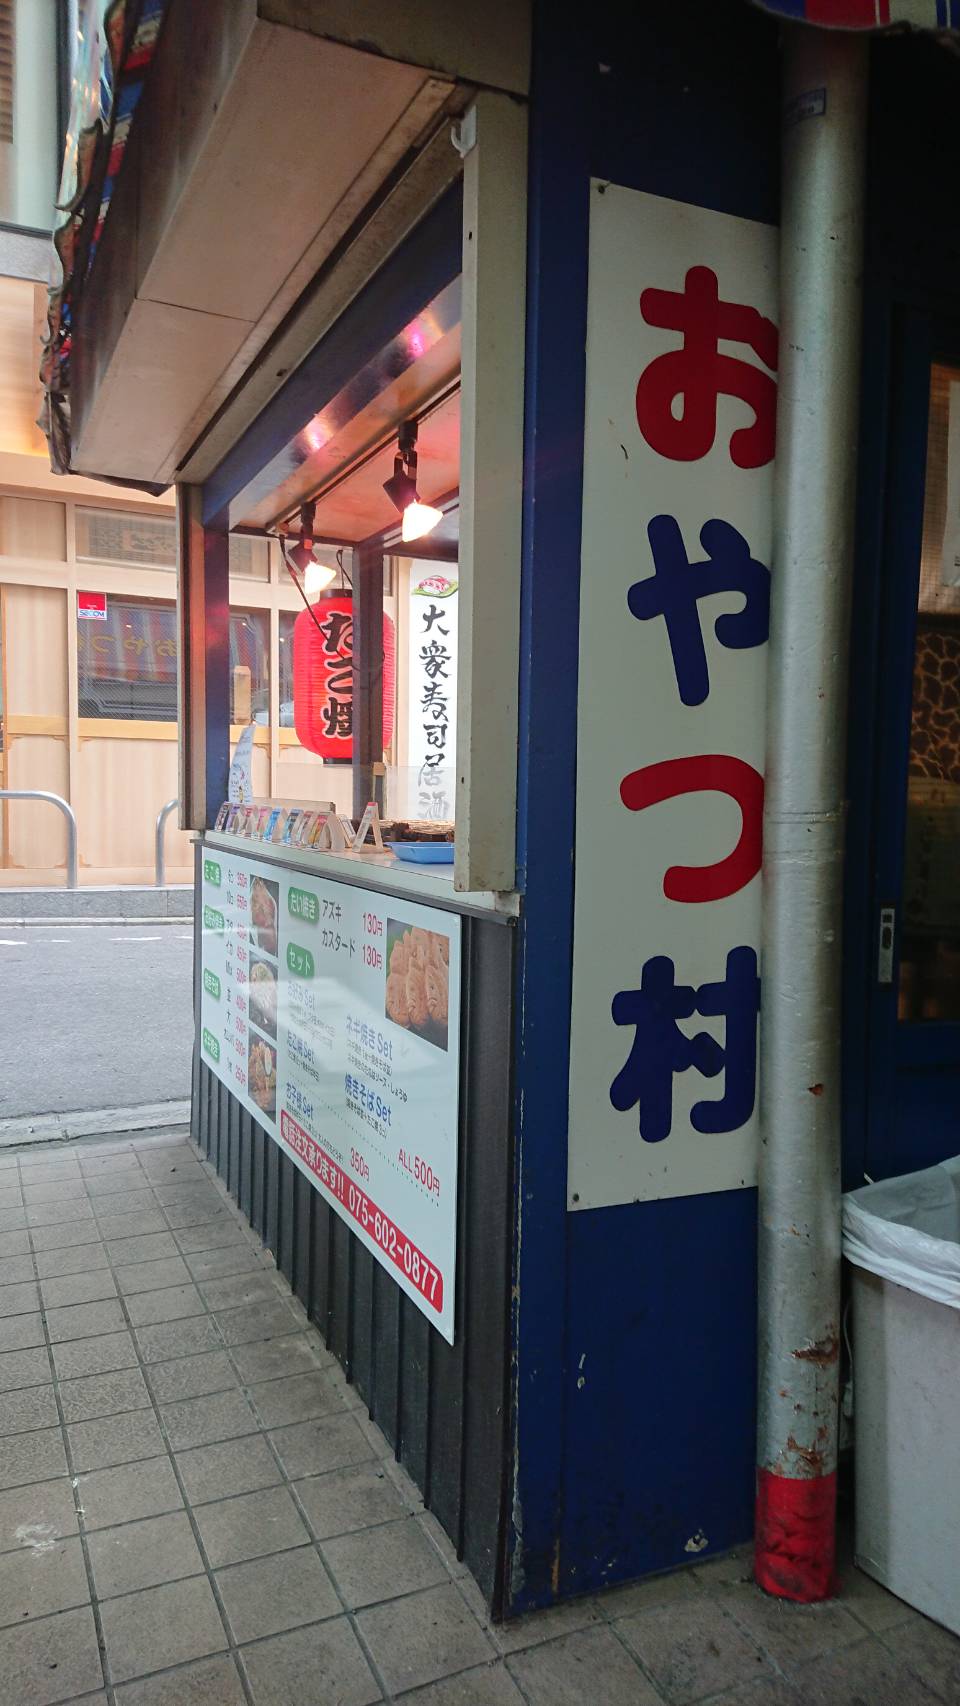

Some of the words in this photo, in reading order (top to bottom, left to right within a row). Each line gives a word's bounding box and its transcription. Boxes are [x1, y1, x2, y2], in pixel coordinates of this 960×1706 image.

[610, 265, 779, 1143] おやつ村
[322, 900, 341, 925] アズキ
[363, 913, 382, 937] 130円
[289, 946, 311, 977] セット
[322, 929, 355, 958] カスタード
[362, 943, 382, 971] 130円
[350, 1145, 369, 1183] 350円
[349, 1182, 438, 1306] 075-602-0877
